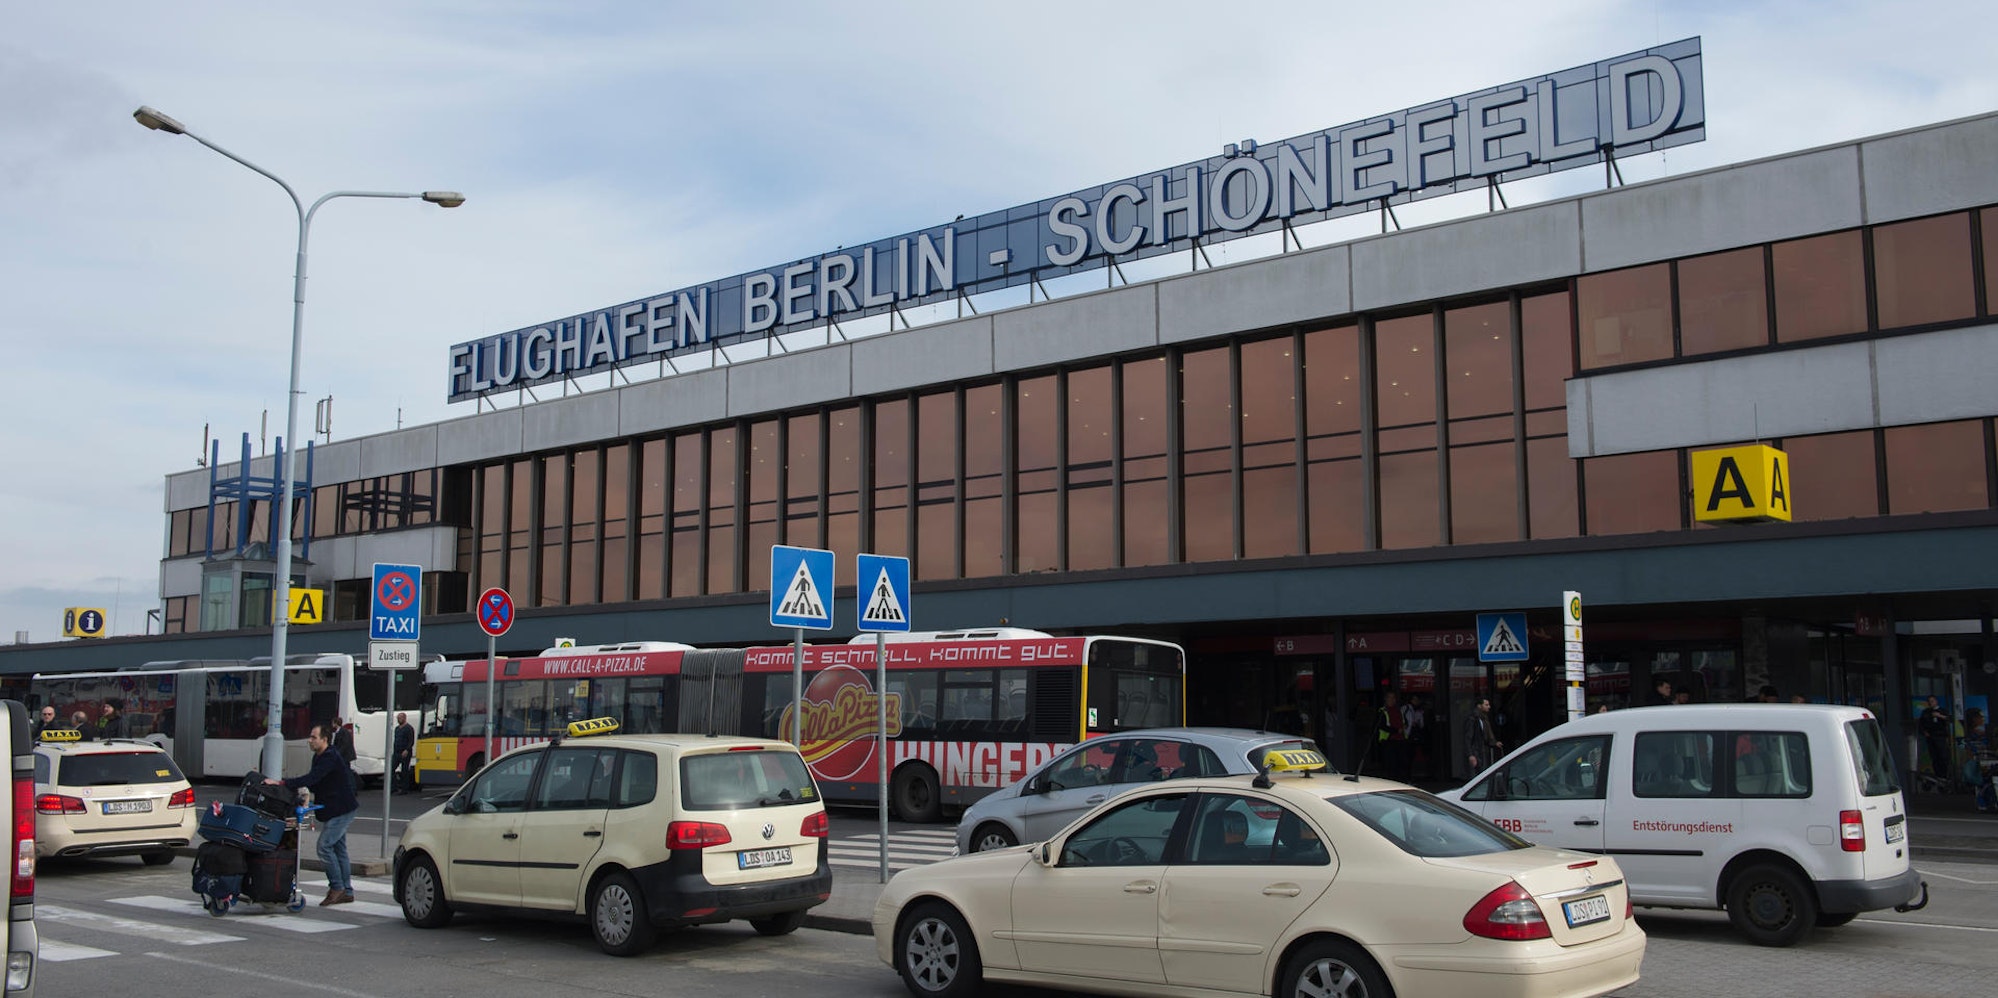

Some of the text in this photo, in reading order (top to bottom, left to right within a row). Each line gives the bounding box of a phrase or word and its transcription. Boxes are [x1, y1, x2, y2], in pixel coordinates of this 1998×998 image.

[448, 286, 711, 397] FLUGHAFEN
[744, 226, 957, 334] BERLIN
[1045, 53, 1686, 267] SCHÖNEFELD
[1706, 456, 1755, 511] A
[1771, 456, 1787, 512] A
[295, 592, 316, 620] A
[376, 616, 415, 634] TAXI
[1286, 640, 1295, 651] B
[1358, 637, 1368, 649] A
[1443, 633, 1464, 646] C D
[378, 649, 410, 663] Zustieg
[543, 656, 647, 674] WWW.CALL-A-PIZZA.DE
[579, 718, 613, 731] TAXI
[1284, 752, 1321, 765] TAXI
[1633, 819, 1734, 835] Entstörungsdienst
[744, 852, 762, 865] LDS
[776, 849, 791, 861] 143
[1568, 903, 1586, 921] LDS
